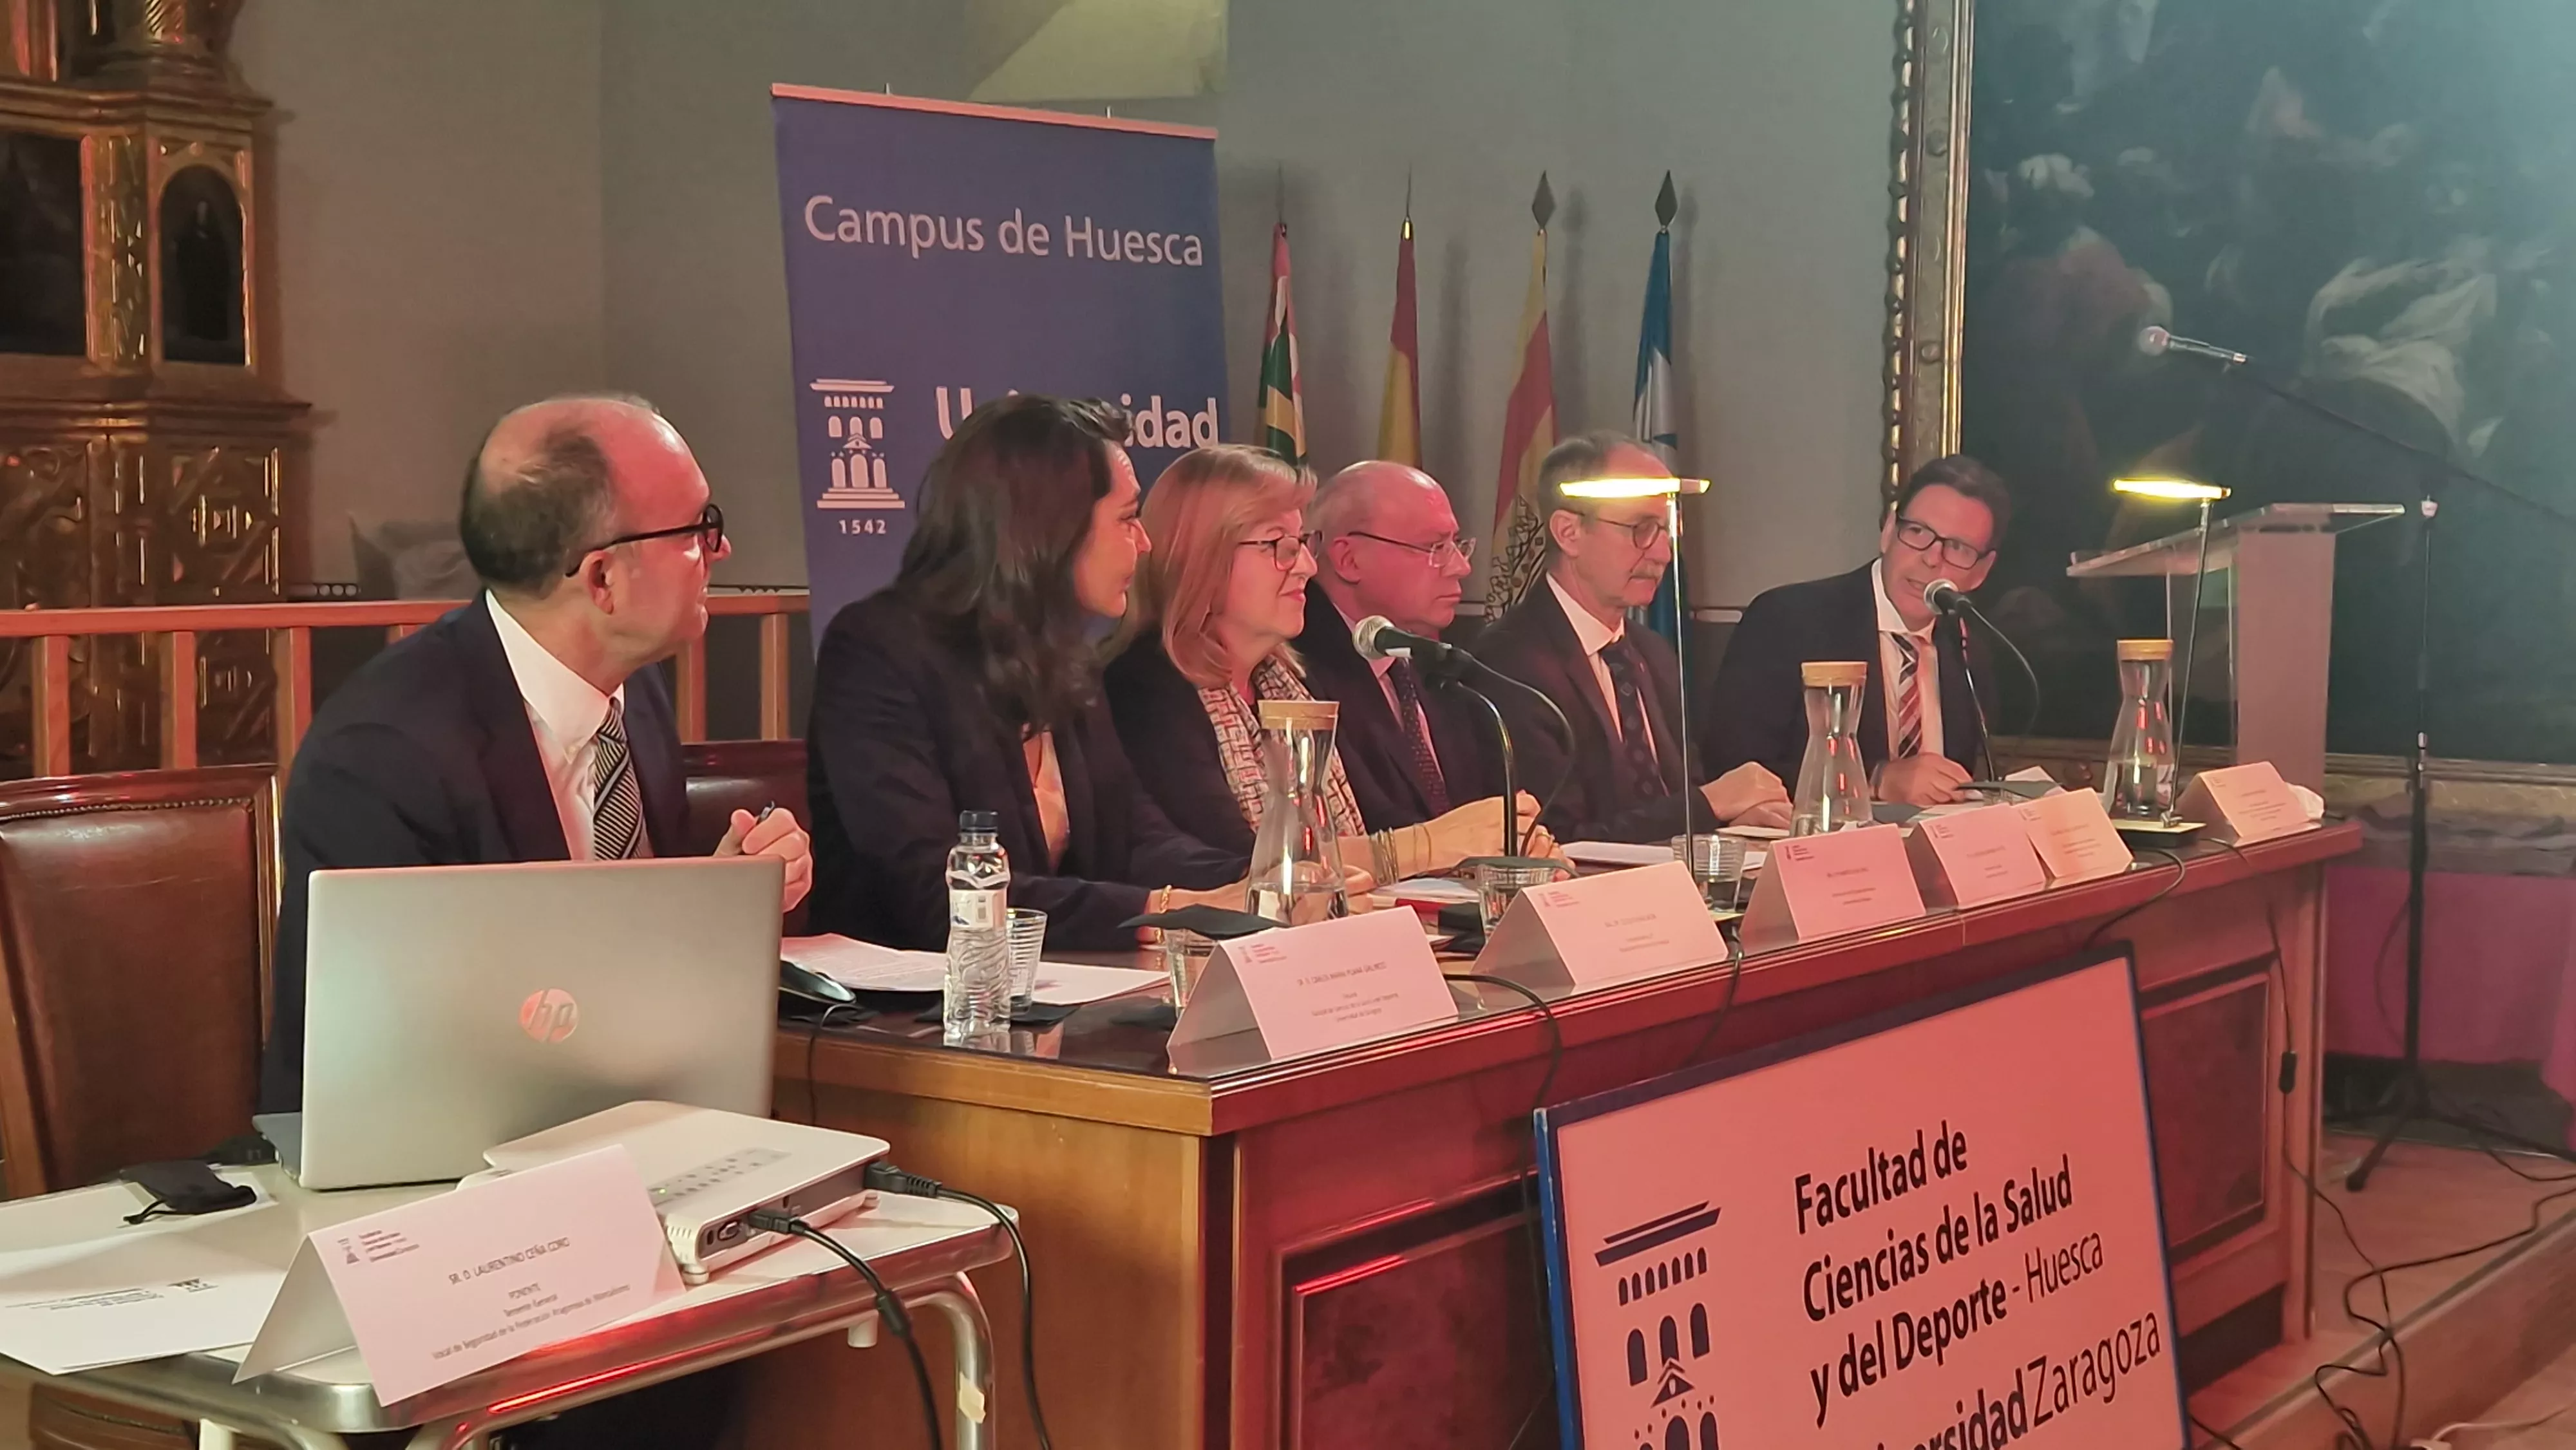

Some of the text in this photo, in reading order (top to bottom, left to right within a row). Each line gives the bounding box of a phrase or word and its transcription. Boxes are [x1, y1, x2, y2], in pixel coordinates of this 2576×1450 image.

[804, 195, 1203, 266] Campus de Huesca
[839, 520, 887, 536] 1542
[523, 988, 578, 1044] hp
[1794, 1119, 1967, 1234] Facultad de
[1803, 1153, 2072, 1321] Ciencias de la Salud
[1810, 1363, 1830, 1429] y
[1838, 1319, 1887, 1397] del
[1892, 1278, 2007, 1370] Deporte
[2025, 1232, 2103, 1303] Huesca
